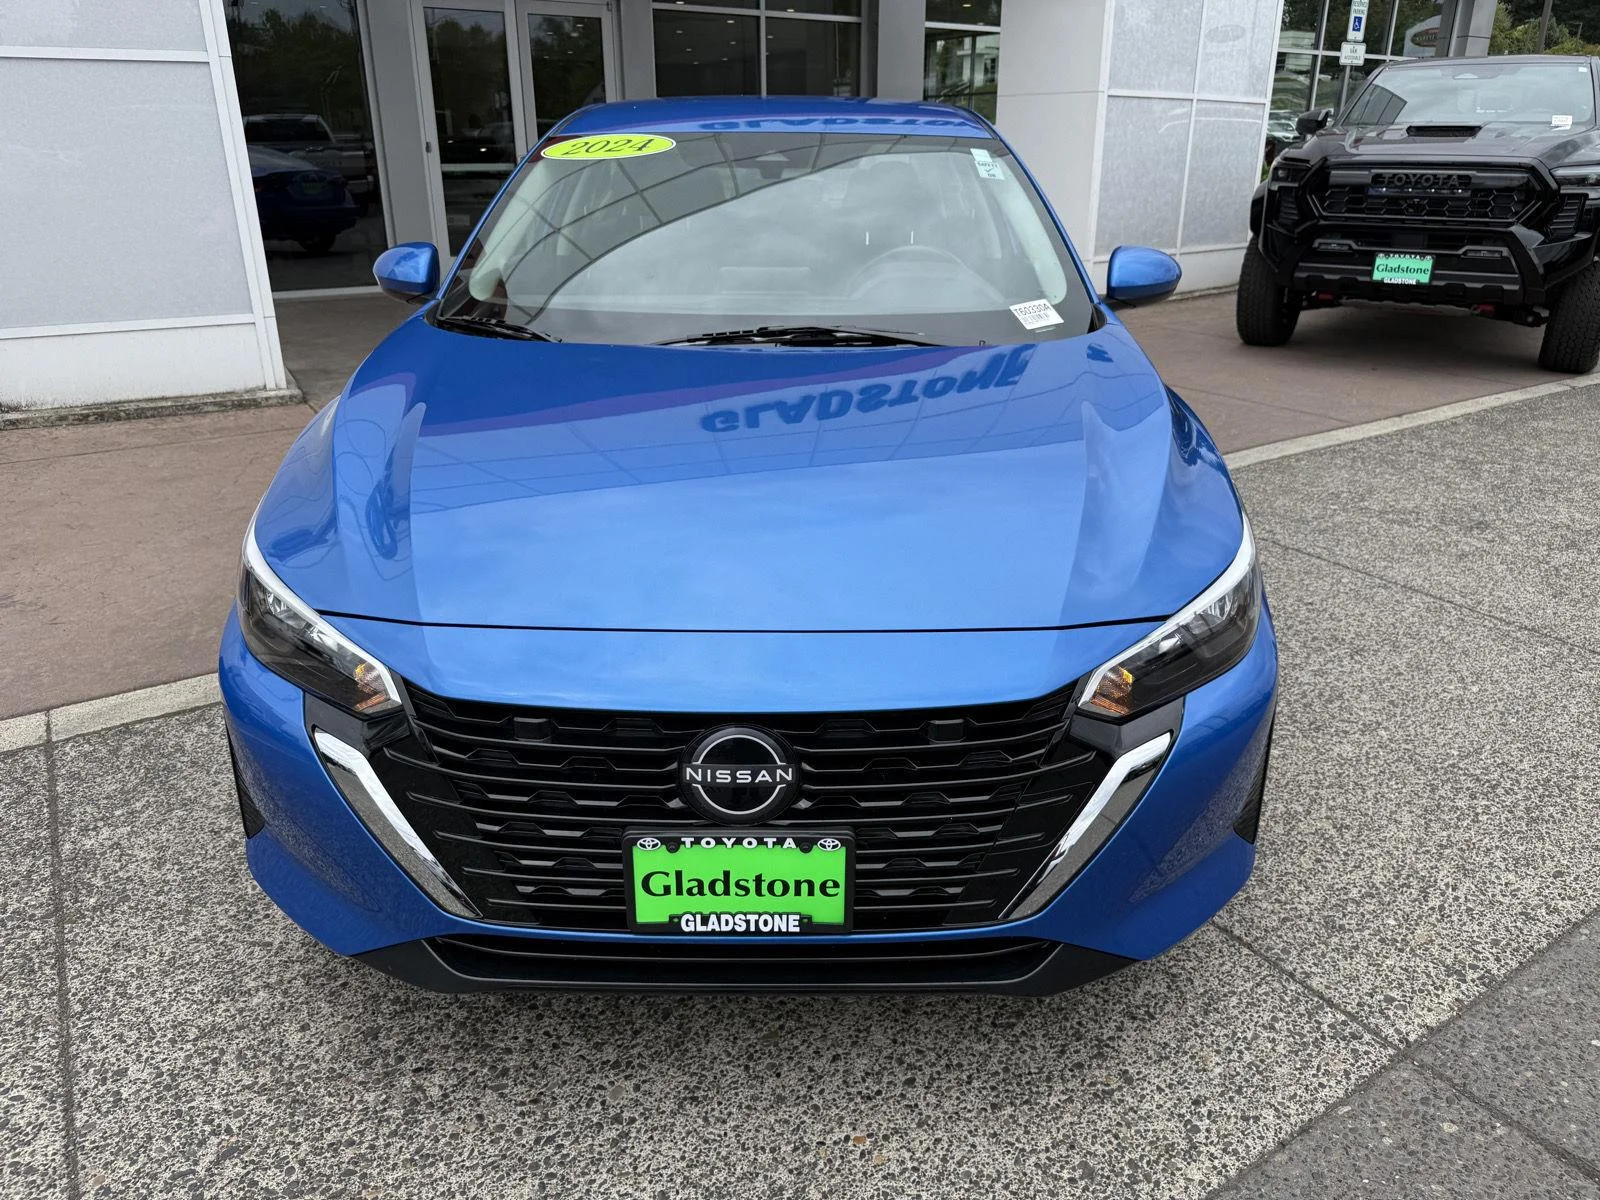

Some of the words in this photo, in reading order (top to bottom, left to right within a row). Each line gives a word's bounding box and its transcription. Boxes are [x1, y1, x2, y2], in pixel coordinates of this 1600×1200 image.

[560, 137, 651, 157] 2024
[1381, 173, 1460, 187] TOYOTA
[1376, 263, 1430, 275] Gladstone
[1384, 277, 1417, 285] GLADSTONE
[686, 766, 793, 784] NISSAN
[681, 837, 797, 849] TOYOTA
[640, 869, 841, 898] Gladstone
[680, 913, 801, 933] GLADSTONE
